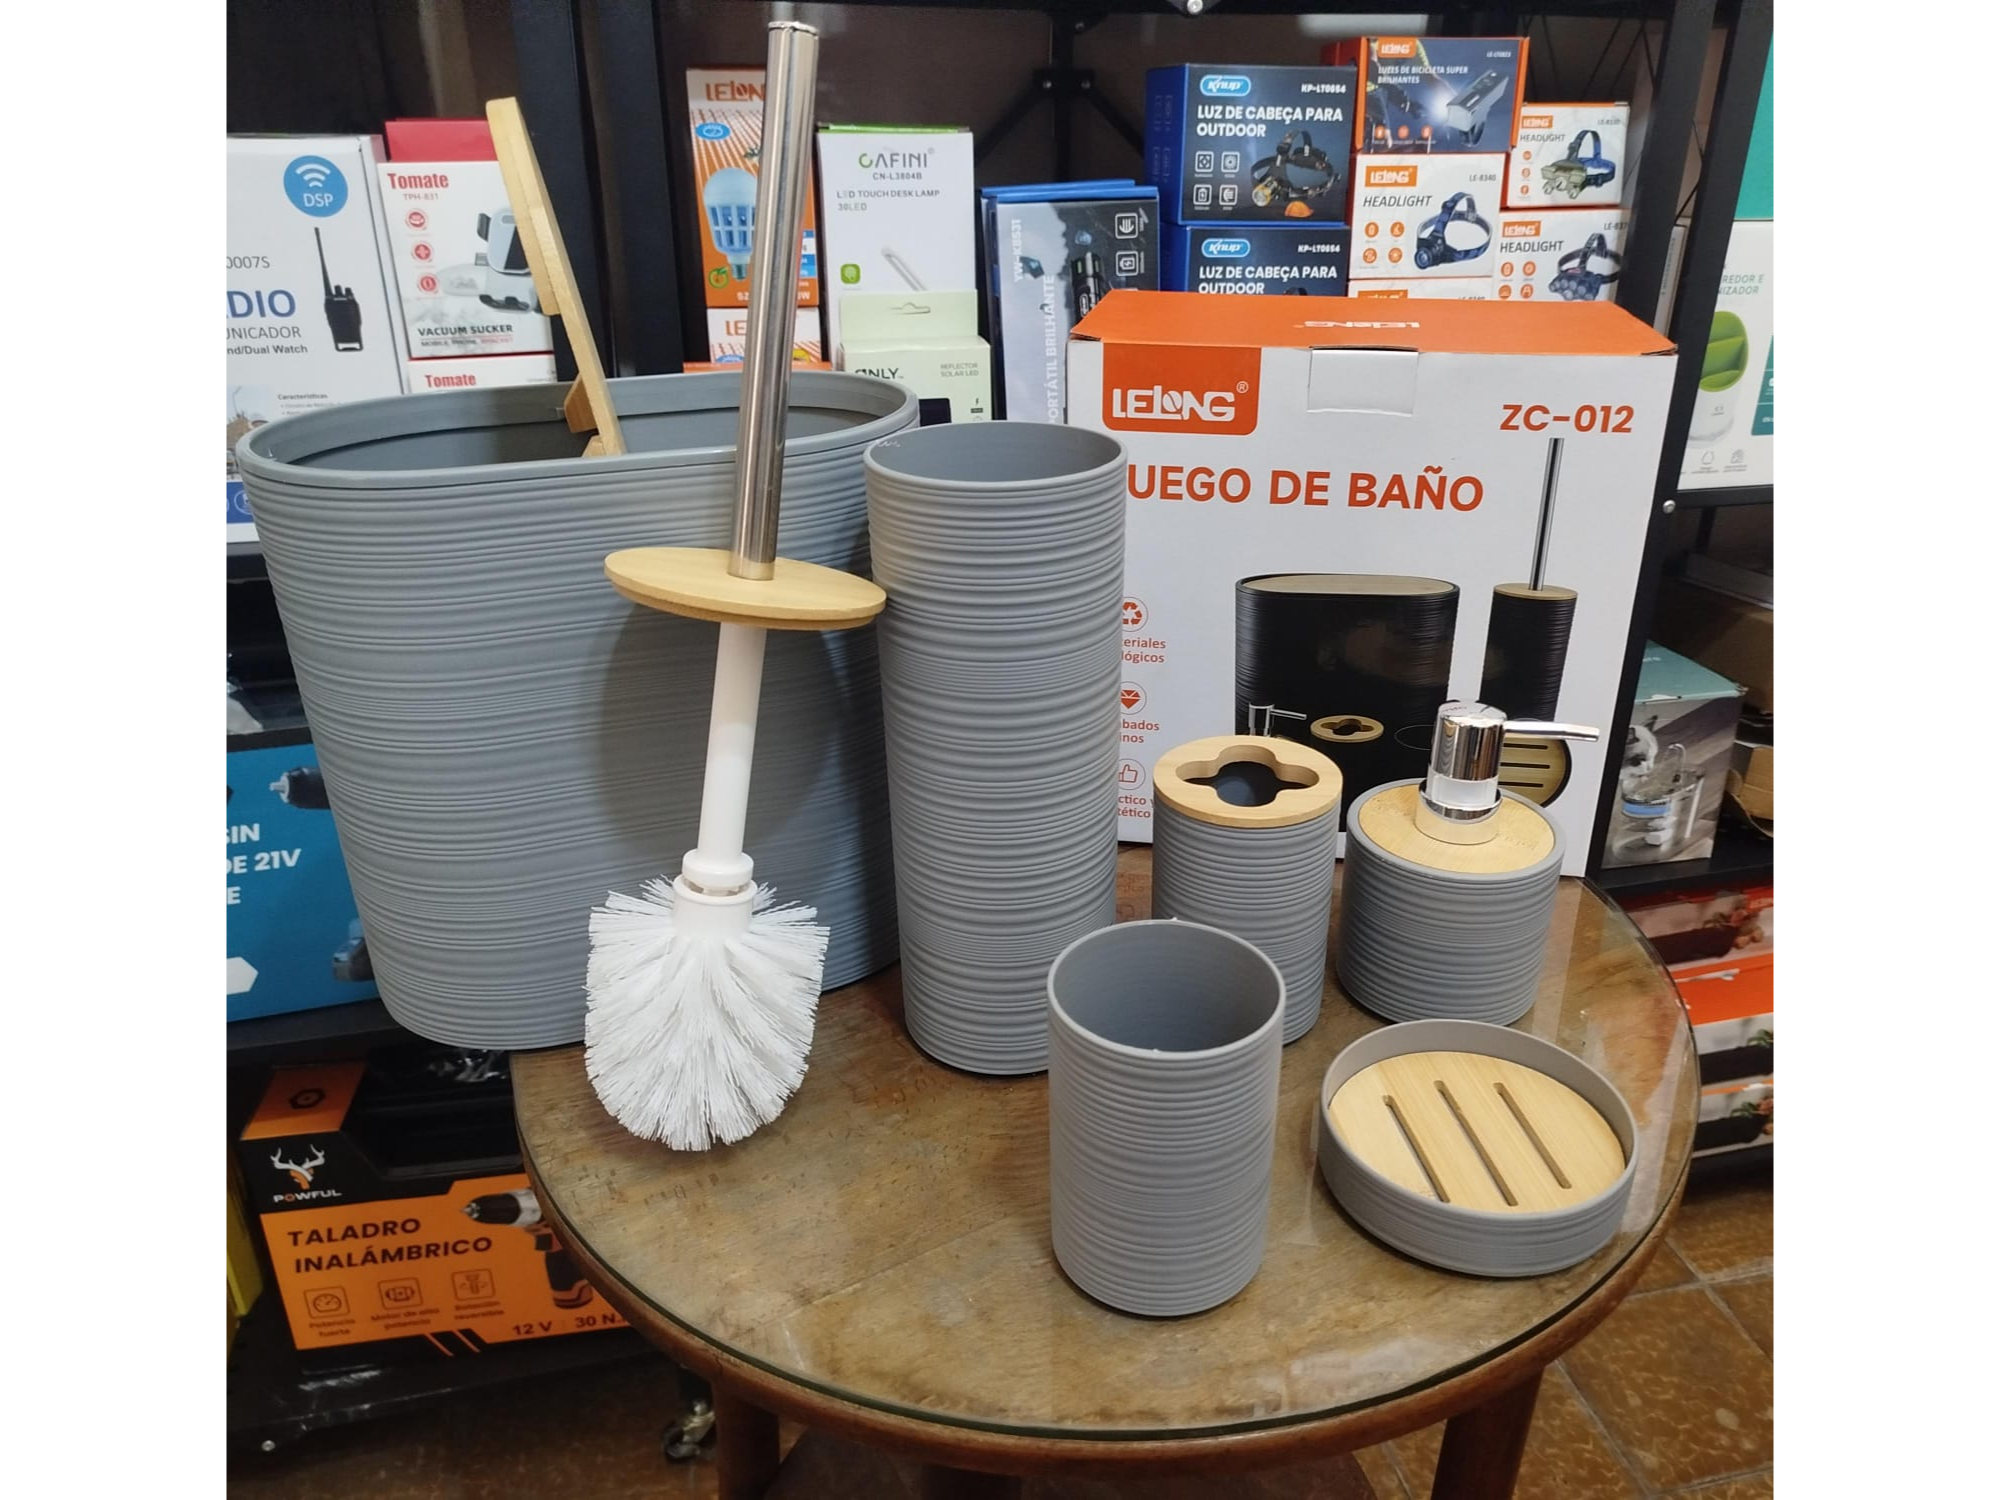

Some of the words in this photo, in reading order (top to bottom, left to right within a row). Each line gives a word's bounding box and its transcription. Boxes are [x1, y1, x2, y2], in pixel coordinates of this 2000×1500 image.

[1401, 66, 1410, 74] DE
[1411, 66, 1445, 74] BICICLETA
[1446, 66, 1469, 74] SUPER
[1377, 76, 1420, 84] BRILHANTES
[1197, 105, 1223, 119] LUZ
[1225, 106, 1243, 120] DE
[1245, 106, 1303, 125] CABEÇA
[1305, 107, 1343, 121] PARA
[1196, 123, 1266, 137] OUTDOOR
[1520, 133, 1566, 142] HEADLIGHT
[387, 172, 450, 189] Tomate
[303, 193, 334, 208] DSP
[858, 189, 890, 198] TOUCH
[891, 189, 914, 198] DESK
[915, 189, 940, 197] LAMP
[1362, 196, 1433, 208] HEADLIGHT
[1499, 240, 1565, 253] HEADLIGHT
[1199, 266, 1223, 279] LUZ
[1225, 267, 1243, 279] DE
[1245, 266, 1300, 282] CABEÇA
[1302, 266, 1338, 279] PARA
[1198, 282, 1265, 294] OUTDOOR
[226, 289, 296, 318] DIO
[1043, 275, 1058, 356] BRILHANTE
[418, 326, 468, 337] VACUUM
[470, 324, 514, 334] SUCKER
[272, 344, 308, 354] Watch
[940, 362, 979, 370] REFLECTOR
[940, 369, 965, 377] SOLAR
[965, 369, 980, 377] LED
[425, 374, 477, 388] Tomate
[1112, 385, 1236, 423] LELONG
[1500, 404, 1634, 434] ZC-012
[1269, 470, 1331, 506] DE
[1347, 465, 1485, 512] BAÑO
[254, 848, 302, 871] 21V
[273, 1189, 342, 1203] POWFUL
[287, 1218, 421, 1247] TALADRO
[294, 1237, 493, 1273] INALÁMBRICO
[512, 1322, 535, 1336] 12
[538, 1321, 553, 1332] V
[574, 1315, 597, 1329] 30
